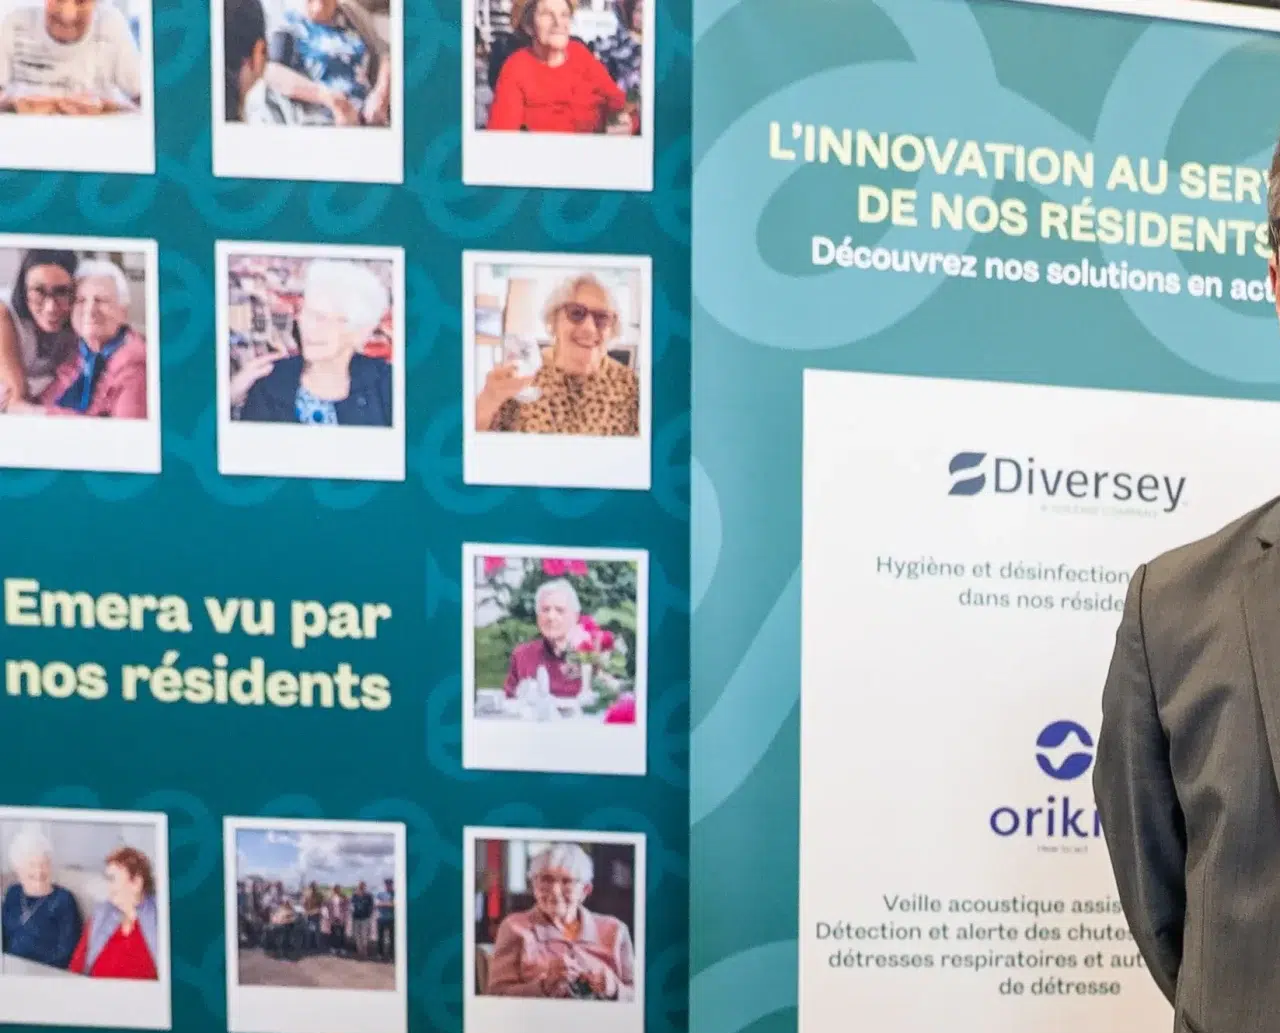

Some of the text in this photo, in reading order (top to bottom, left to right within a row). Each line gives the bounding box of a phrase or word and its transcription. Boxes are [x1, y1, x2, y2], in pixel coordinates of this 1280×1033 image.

[1107, 158, 1168, 196] AU
[858, 187, 1274, 260] DE NOS RÉSIDENTS
[811, 236, 977, 278] Découvrez
[984, 257, 1040, 284] nos
[1046, 258, 1181, 295] solutions
[1187, 273, 1223, 298] en
[994, 457, 1187, 513] Diversey
[876, 555, 1131, 584] Hygiène et désinfection
[4, 577, 392, 649] Emera vu par
[958, 588, 1125, 613] dans nos réside
[5, 650, 392, 712] nos résidents
[883, 894, 942, 913] Veille
[949, 894, 1065, 918] acoustique
[816, 920, 922, 942] Détection
[929, 923, 949, 941] et
[956, 921, 1018, 942] alerte
[1025, 921, 1061, 941] des
[828, 947, 934, 969] détresses
[941, 948, 1077, 972] respiratoires
[1083, 951, 1104, 968] et
[999, 976, 1121, 996] de détresse
